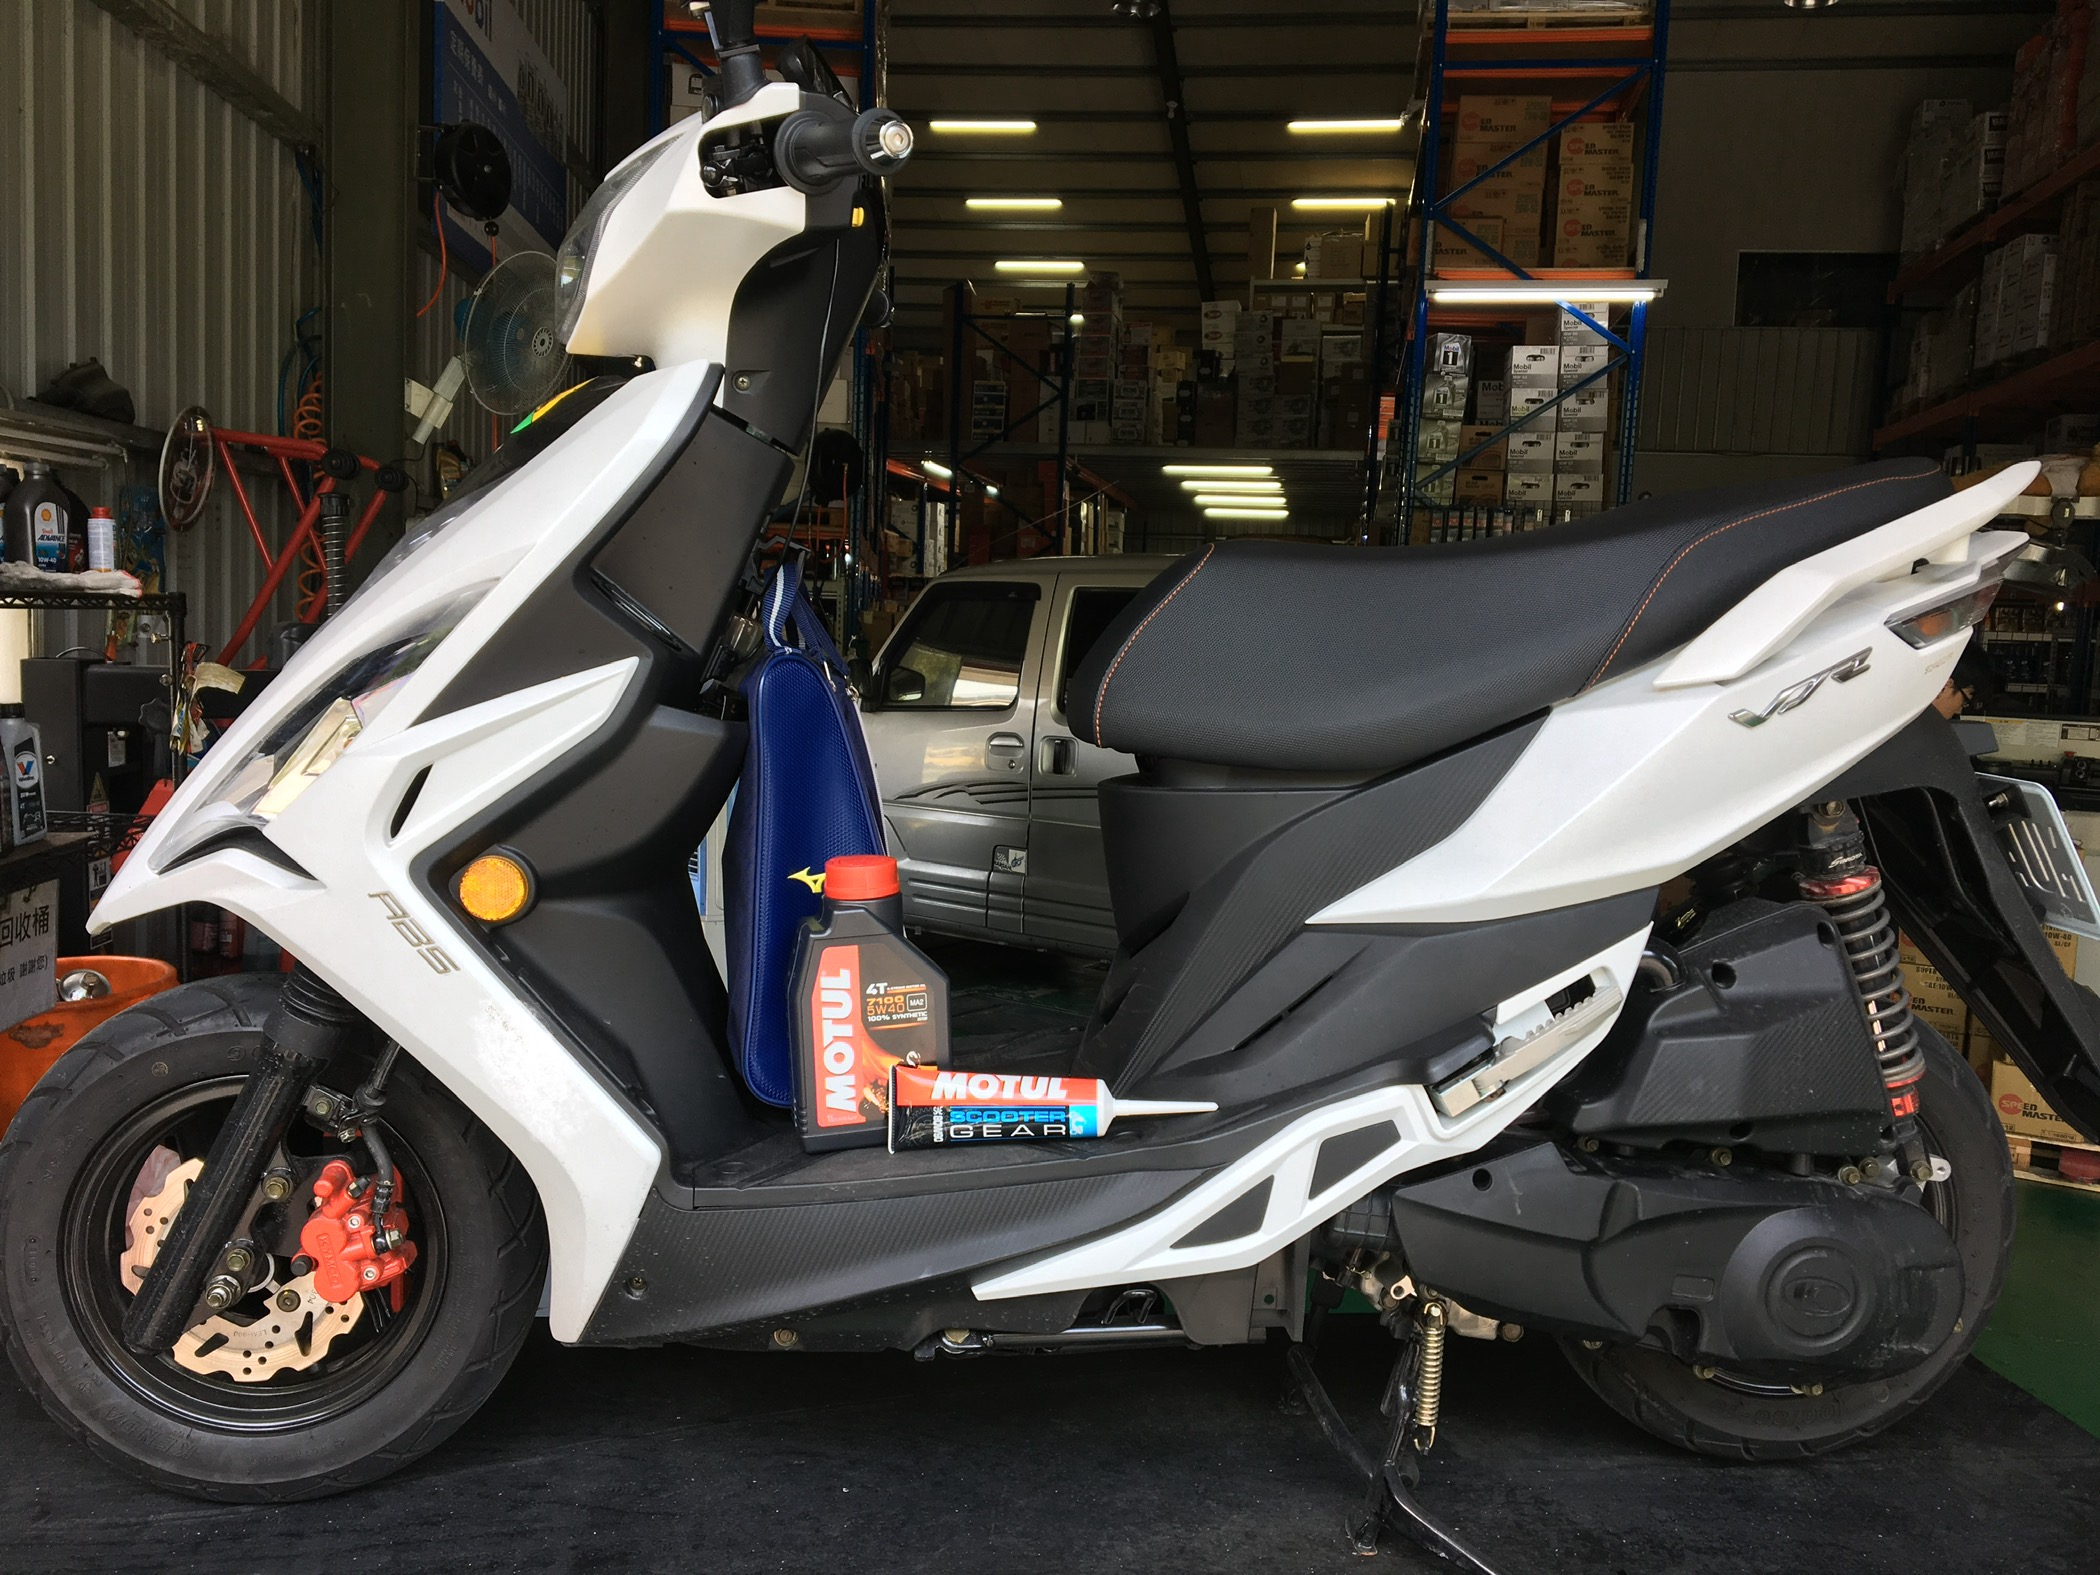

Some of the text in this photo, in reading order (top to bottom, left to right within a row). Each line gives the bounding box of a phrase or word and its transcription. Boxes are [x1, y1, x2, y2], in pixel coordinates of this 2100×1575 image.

[37, 534, 66, 542] ADVANCE
[367, 890, 461, 975] ABS
[866, 982, 888, 995] 4T
[866, 995, 905, 1006] 7100
[909, 998, 924, 1006] MA2
[867, 1003, 905, 1016] 5W40
[867, 1010, 928, 1022] 100% SYNTHETIC
[1911, 1004, 1954, 1015] MASTER
[820, 968, 857, 1113] MOTUL
[931, 1071, 1069, 1100] MOTUL
[949, 1110, 1066, 1123] SCOOTER
[949, 1124, 1066, 1139] GEAR
[319, 1235, 341, 1287] KYMCO
[102, 1406, 196, 1459] KENDA
